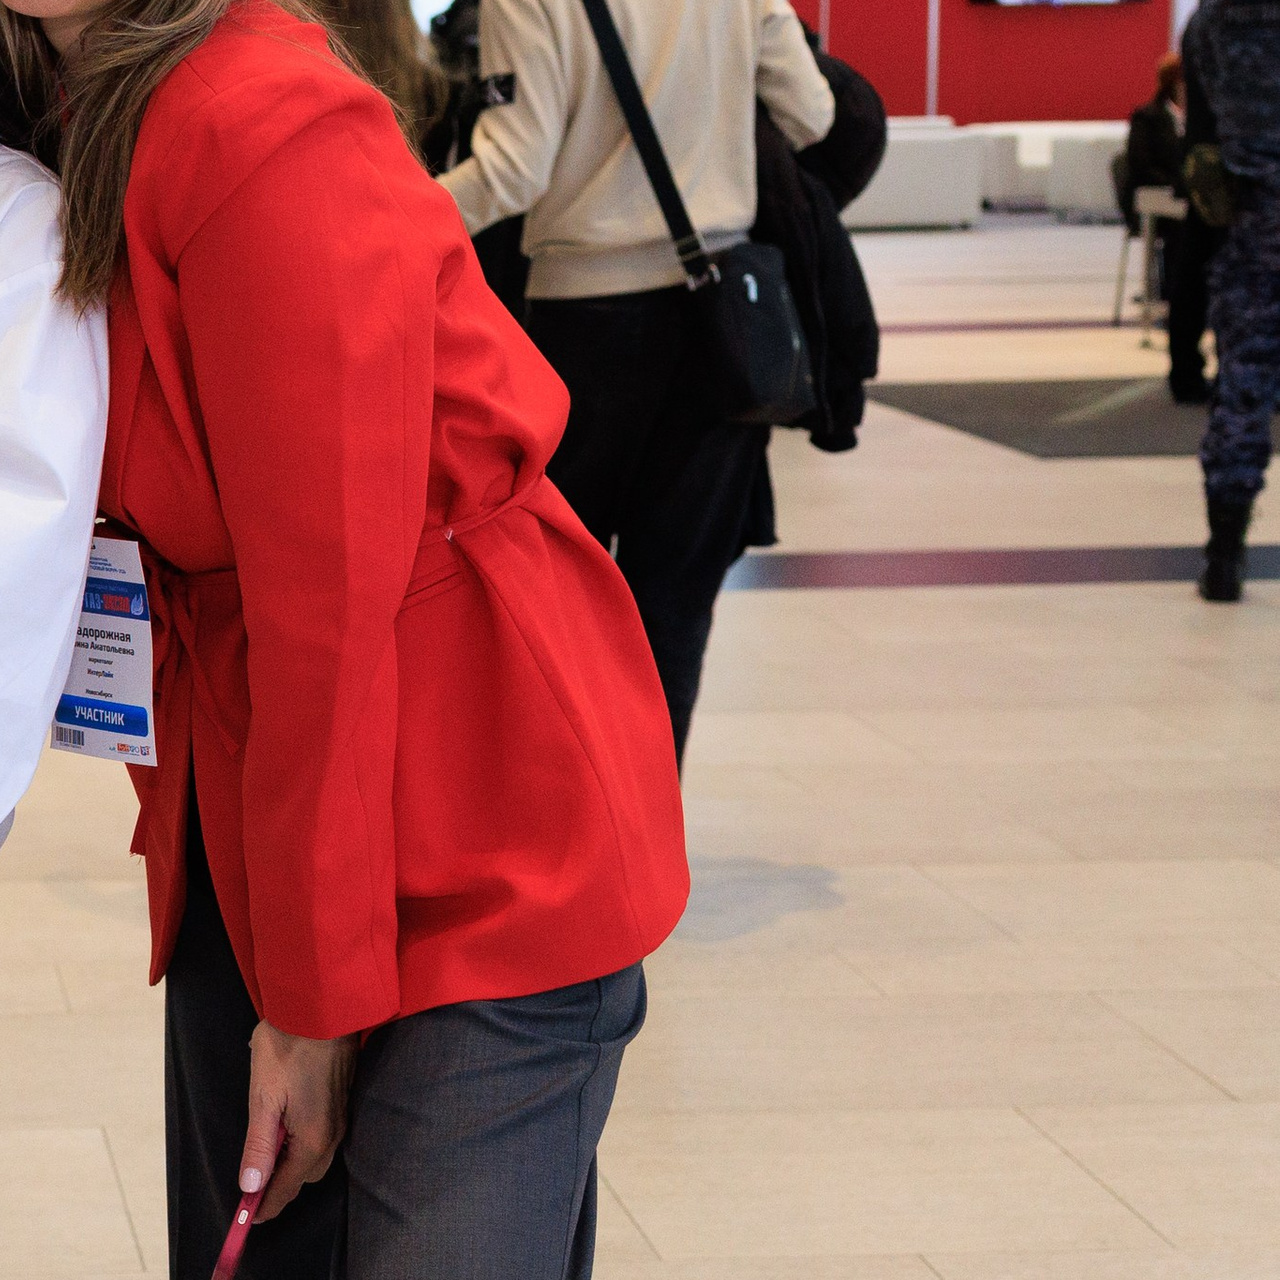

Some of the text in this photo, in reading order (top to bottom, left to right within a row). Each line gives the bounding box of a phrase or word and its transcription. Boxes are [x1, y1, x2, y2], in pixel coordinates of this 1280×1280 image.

[76, 626, 132, 643] адорожная
[90, 641, 135, 656] Анатольевна
[74, 705, 125, 727] УЧАСТНИК
